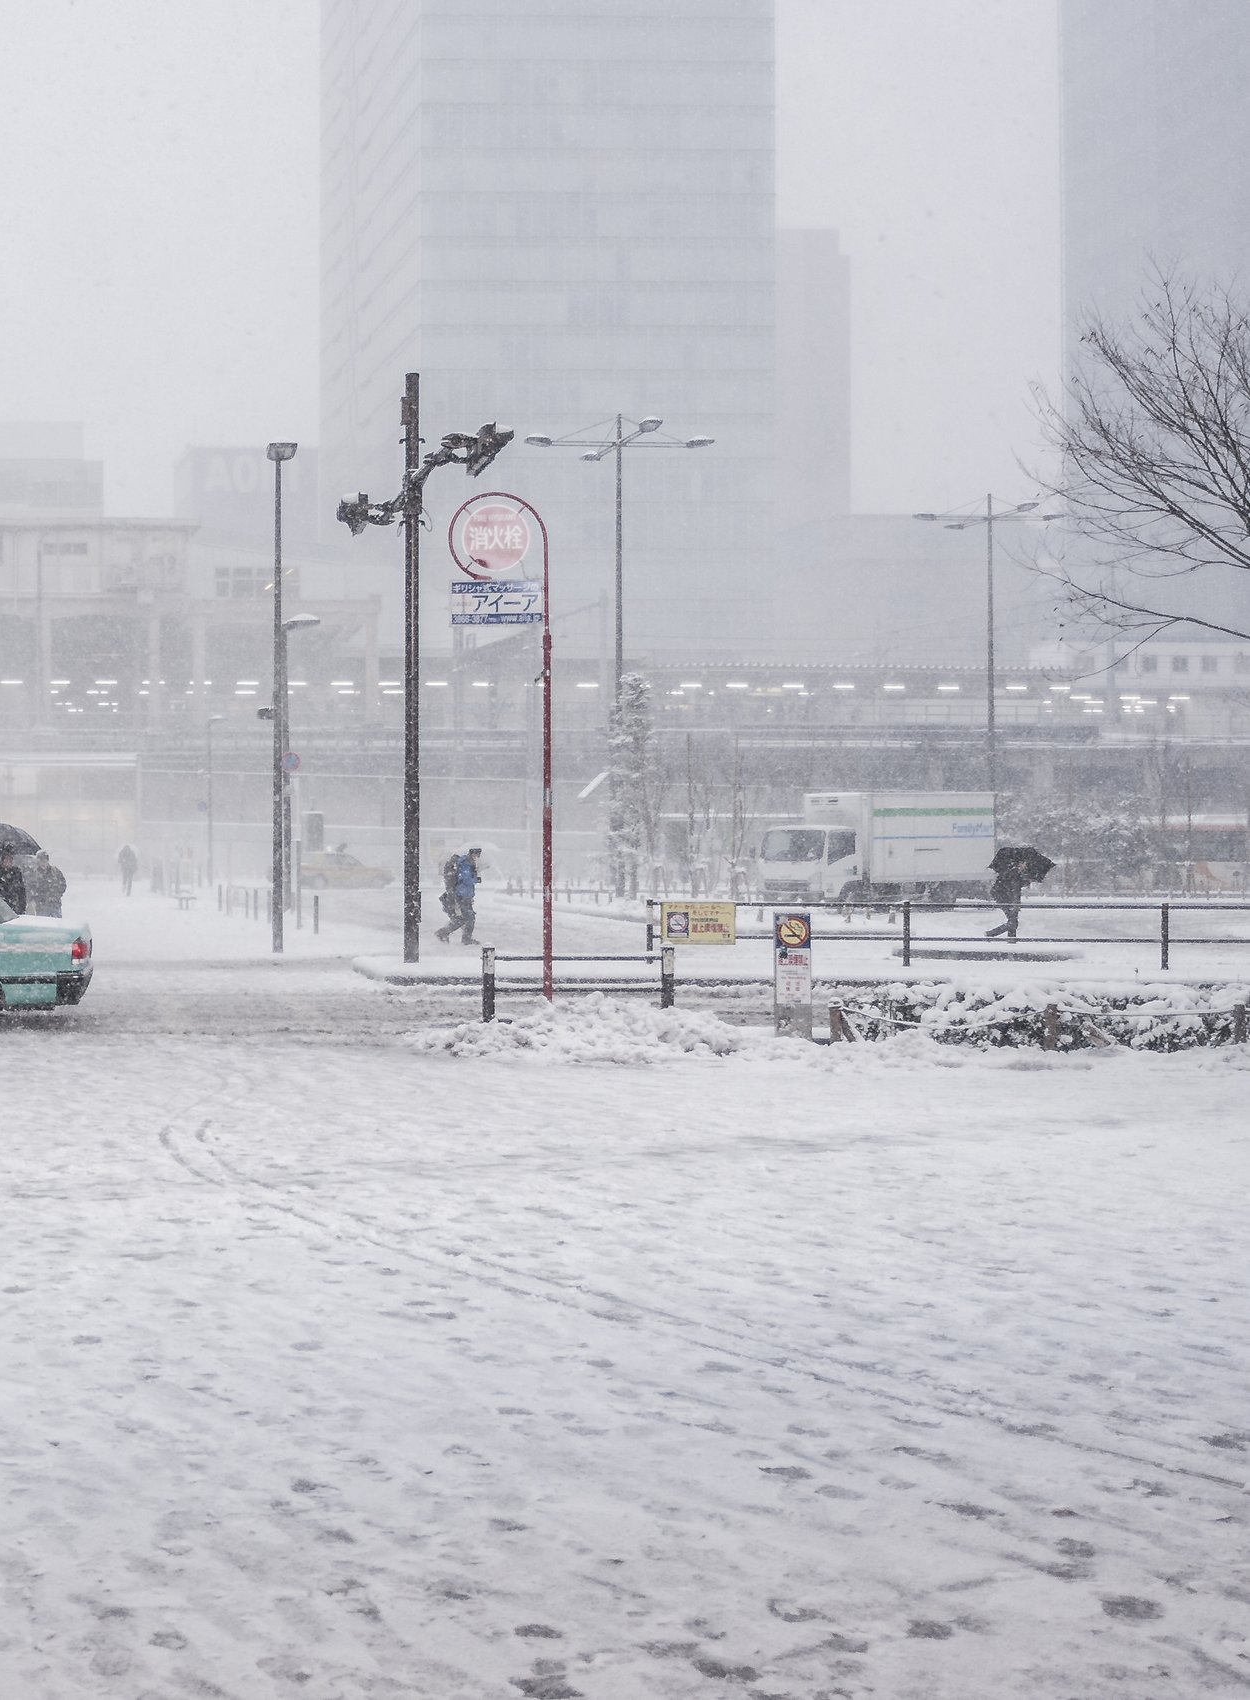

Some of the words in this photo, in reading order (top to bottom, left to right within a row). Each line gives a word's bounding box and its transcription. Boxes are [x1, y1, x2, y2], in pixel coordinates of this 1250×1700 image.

[470, 525, 523, 550] 消火栓
[453, 583, 539, 592] ギリシャ式マッサージの
[472, 595, 538, 612] アイーア
